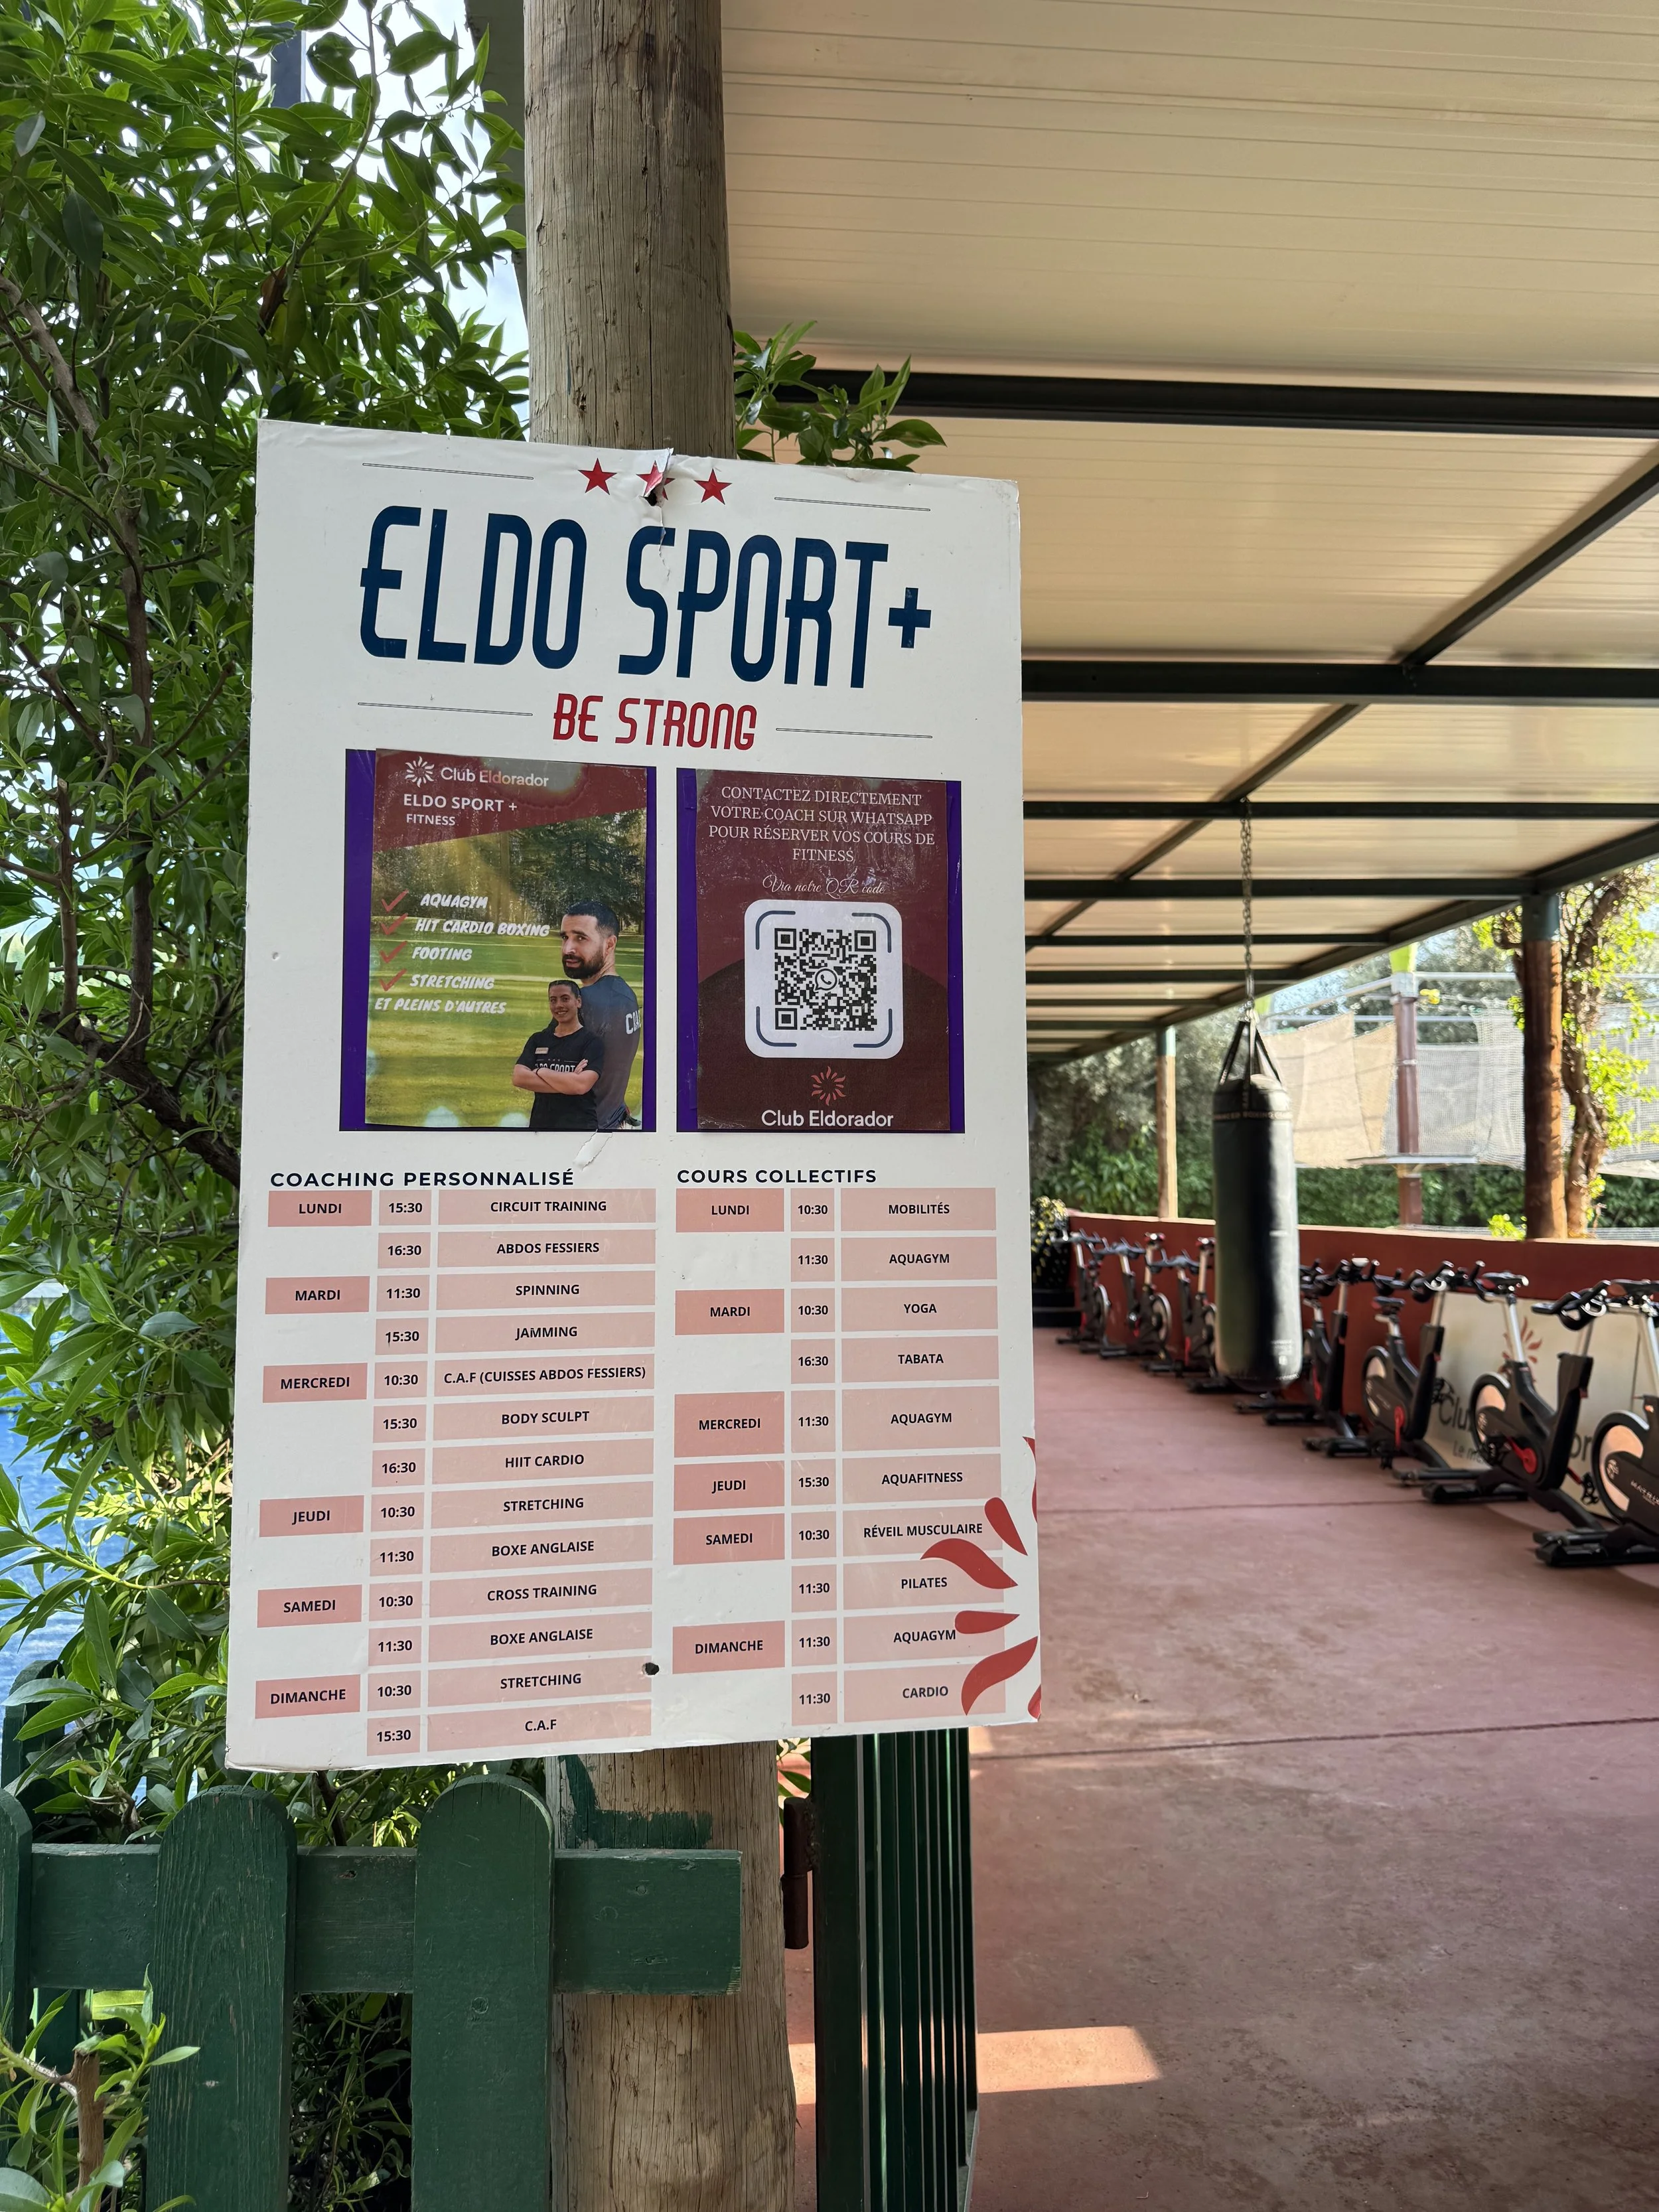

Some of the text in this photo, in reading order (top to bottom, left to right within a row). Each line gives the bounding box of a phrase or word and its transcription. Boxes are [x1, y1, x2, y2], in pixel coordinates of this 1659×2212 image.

[360, 506, 587, 669] ELDO
[553, 693, 757, 751] BE STRONG
[441, 767, 549, 786] Club Eldorador
[403, 794, 447, 808] ELDO
[451, 797, 504, 812] SPORT
[721, 786, 922, 806] CONTACTEZ DIRECTEMENT
[406, 814, 455, 826] FITNESS
[711, 806, 932, 826] VOTRE COACH SUR WHATSAPP
[709, 825, 935, 845] POUR RÉSERVER VOS COURS DE
[792, 849, 853, 862] FITNESS
[762, 875, 886, 899] Via notre QR code
[421, 893, 488, 909] AQUAGYM
[415, 919, 550, 936] HIT CARDIO BOXING
[412, 947, 472, 961] FOOTING
[410, 974, 494, 990] STRETCHING
[375, 997, 507, 1013] ET PLEINS D'AUTRES
[761, 1110, 893, 1128] Club Eldorador
[270, 1168, 573, 1187] COACHING PERSONNALISÉ
[677, 1169, 877, 1183] COURS COLLECTIFS
[299, 1203, 342, 1215] LUNDI
[388, 1202, 423, 1213] 15:30
[490, 1201, 607, 1213] CIRCUIT TRAINING
[711, 1205, 749, 1215] LUNDI
[798, 1205, 828, 1215] 10:30
[889, 1201, 950, 1215] MOBILITÉS
[388, 1245, 422, 1256] 16:30
[496, 1242, 600, 1254] ABDOS FESSIERS
[798, 1254, 828, 1265] 11:30
[889, 1254, 950, 1266] AQUAGYM
[295, 1290, 340, 1301] MARDI
[386, 1288, 421, 1299] 11:30
[515, 1284, 579, 1296] SPINNING
[710, 1306, 751, 1317] MARDI
[798, 1305, 829, 1315] 10:30
[903, 1303, 937, 1314] YOGA
[385, 1331, 419, 1345] 15:30
[514, 1326, 577, 1341] JAMMING
[798, 1356, 829, 1366] 16:30
[897, 1353, 944, 1364] TABATA
[384, 1374, 419, 1386] 10:30
[444, 1366, 646, 1384] C.A.F (CUISSES ABDOS FESSIERS)
[281, 1376, 350, 1390] MERCREDI
[383, 1418, 417, 1430] 15:30
[502, 1411, 590, 1425] BODY SCULPT
[699, 1418, 760, 1430] MERCREDI
[798, 1416, 829, 1427] 11:30
[890, 1412, 952, 1426] AQUAGYM
[382, 1461, 416, 1474] 16:30
[505, 1454, 585, 1468] HIIT CARDIO
[798, 1476, 830, 1488] 15:30
[881, 1471, 963, 1487] AQUAFITNESS
[711, 1479, 746, 1495] JEUDI
[503, 1497, 584, 1512] STRETCHING
[291, 1510, 330, 1526] JEUDI
[380, 1506, 415, 1518] 10:30
[798, 1529, 830, 1541] 10:30
[863, 1523, 983, 1538] RÉVEIL MUSCULAIRE
[705, 1532, 753, 1546] SAMEDI
[492, 1540, 595, 1557] BOXE ANGLAISE
[380, 1550, 414, 1563] 11:30
[798, 1582, 830, 1594] 11:30
[901, 1577, 948, 1589] PILATES
[487, 1584, 597, 1601] CROSS TRAINING
[283, 1599, 336, 1613] SAMEDI
[379, 1595, 413, 1607] 10:30
[490, 1628, 593, 1646] BOXE ANGLAISE
[799, 1636, 830, 1648] 11:30
[893, 1629, 956, 1645] AQUAGYM
[378, 1640, 413, 1653] 11:30
[695, 1639, 763, 1655] DIMANCHE
[500, 1673, 581, 1689] STRETCHING
[270, 1688, 346, 1705] DIMANCHE
[377, 1684, 412, 1698] 10:30
[902, 1686, 949, 1698] CARDIO
[799, 1692, 831, 1705] 11:30
[525, 1719, 557, 1732] C.A.F
[376, 1729, 411, 1742] 15:30
